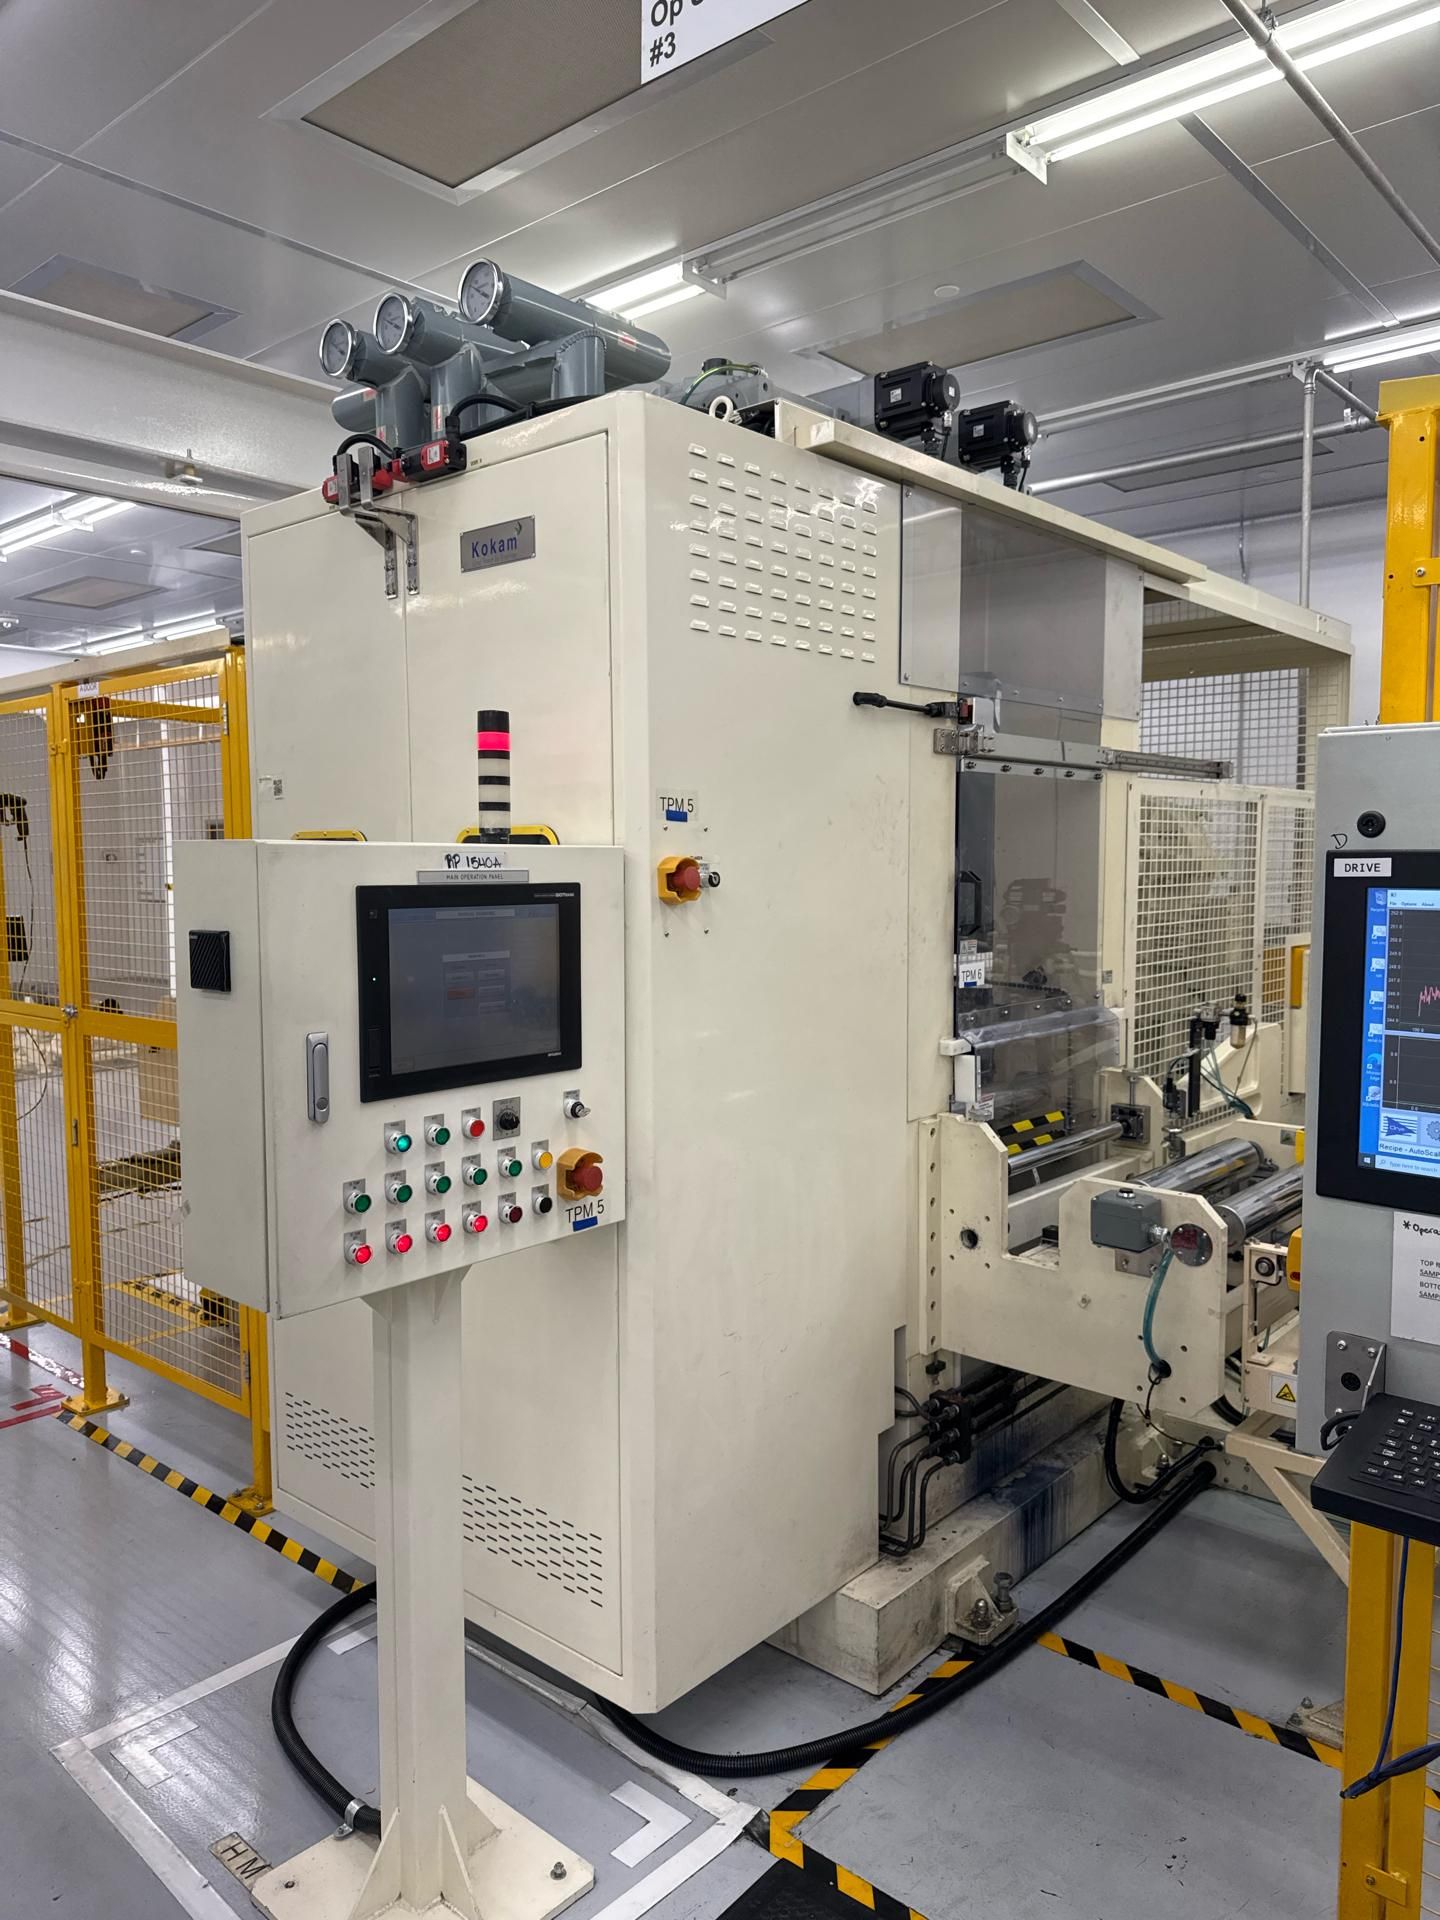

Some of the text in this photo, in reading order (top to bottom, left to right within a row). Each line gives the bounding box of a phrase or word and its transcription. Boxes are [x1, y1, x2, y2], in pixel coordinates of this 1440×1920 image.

[651, 0, 683, 27] Op
[650, 32, 676, 67] #3
[471, 536, 518, 558] Kokam
[660, 797, 694, 812] TPM 5
[1344, 863, 1382, 873] DRIVE
[961, 968, 982, 981] TPM 6
[1380, 1143, 1403, 1153] Recipe
[565, 1199, 605, 1224] TPM 5
[1403, 1220, 1440, 1236] Opera
[1420, 1259, 1434, 1267] TOP
[1419, 1269, 1440, 1277] SAMP
[1420, 1281, 1440, 1290] BOTTO
[1419, 1291, 1440, 1299] SAMP
